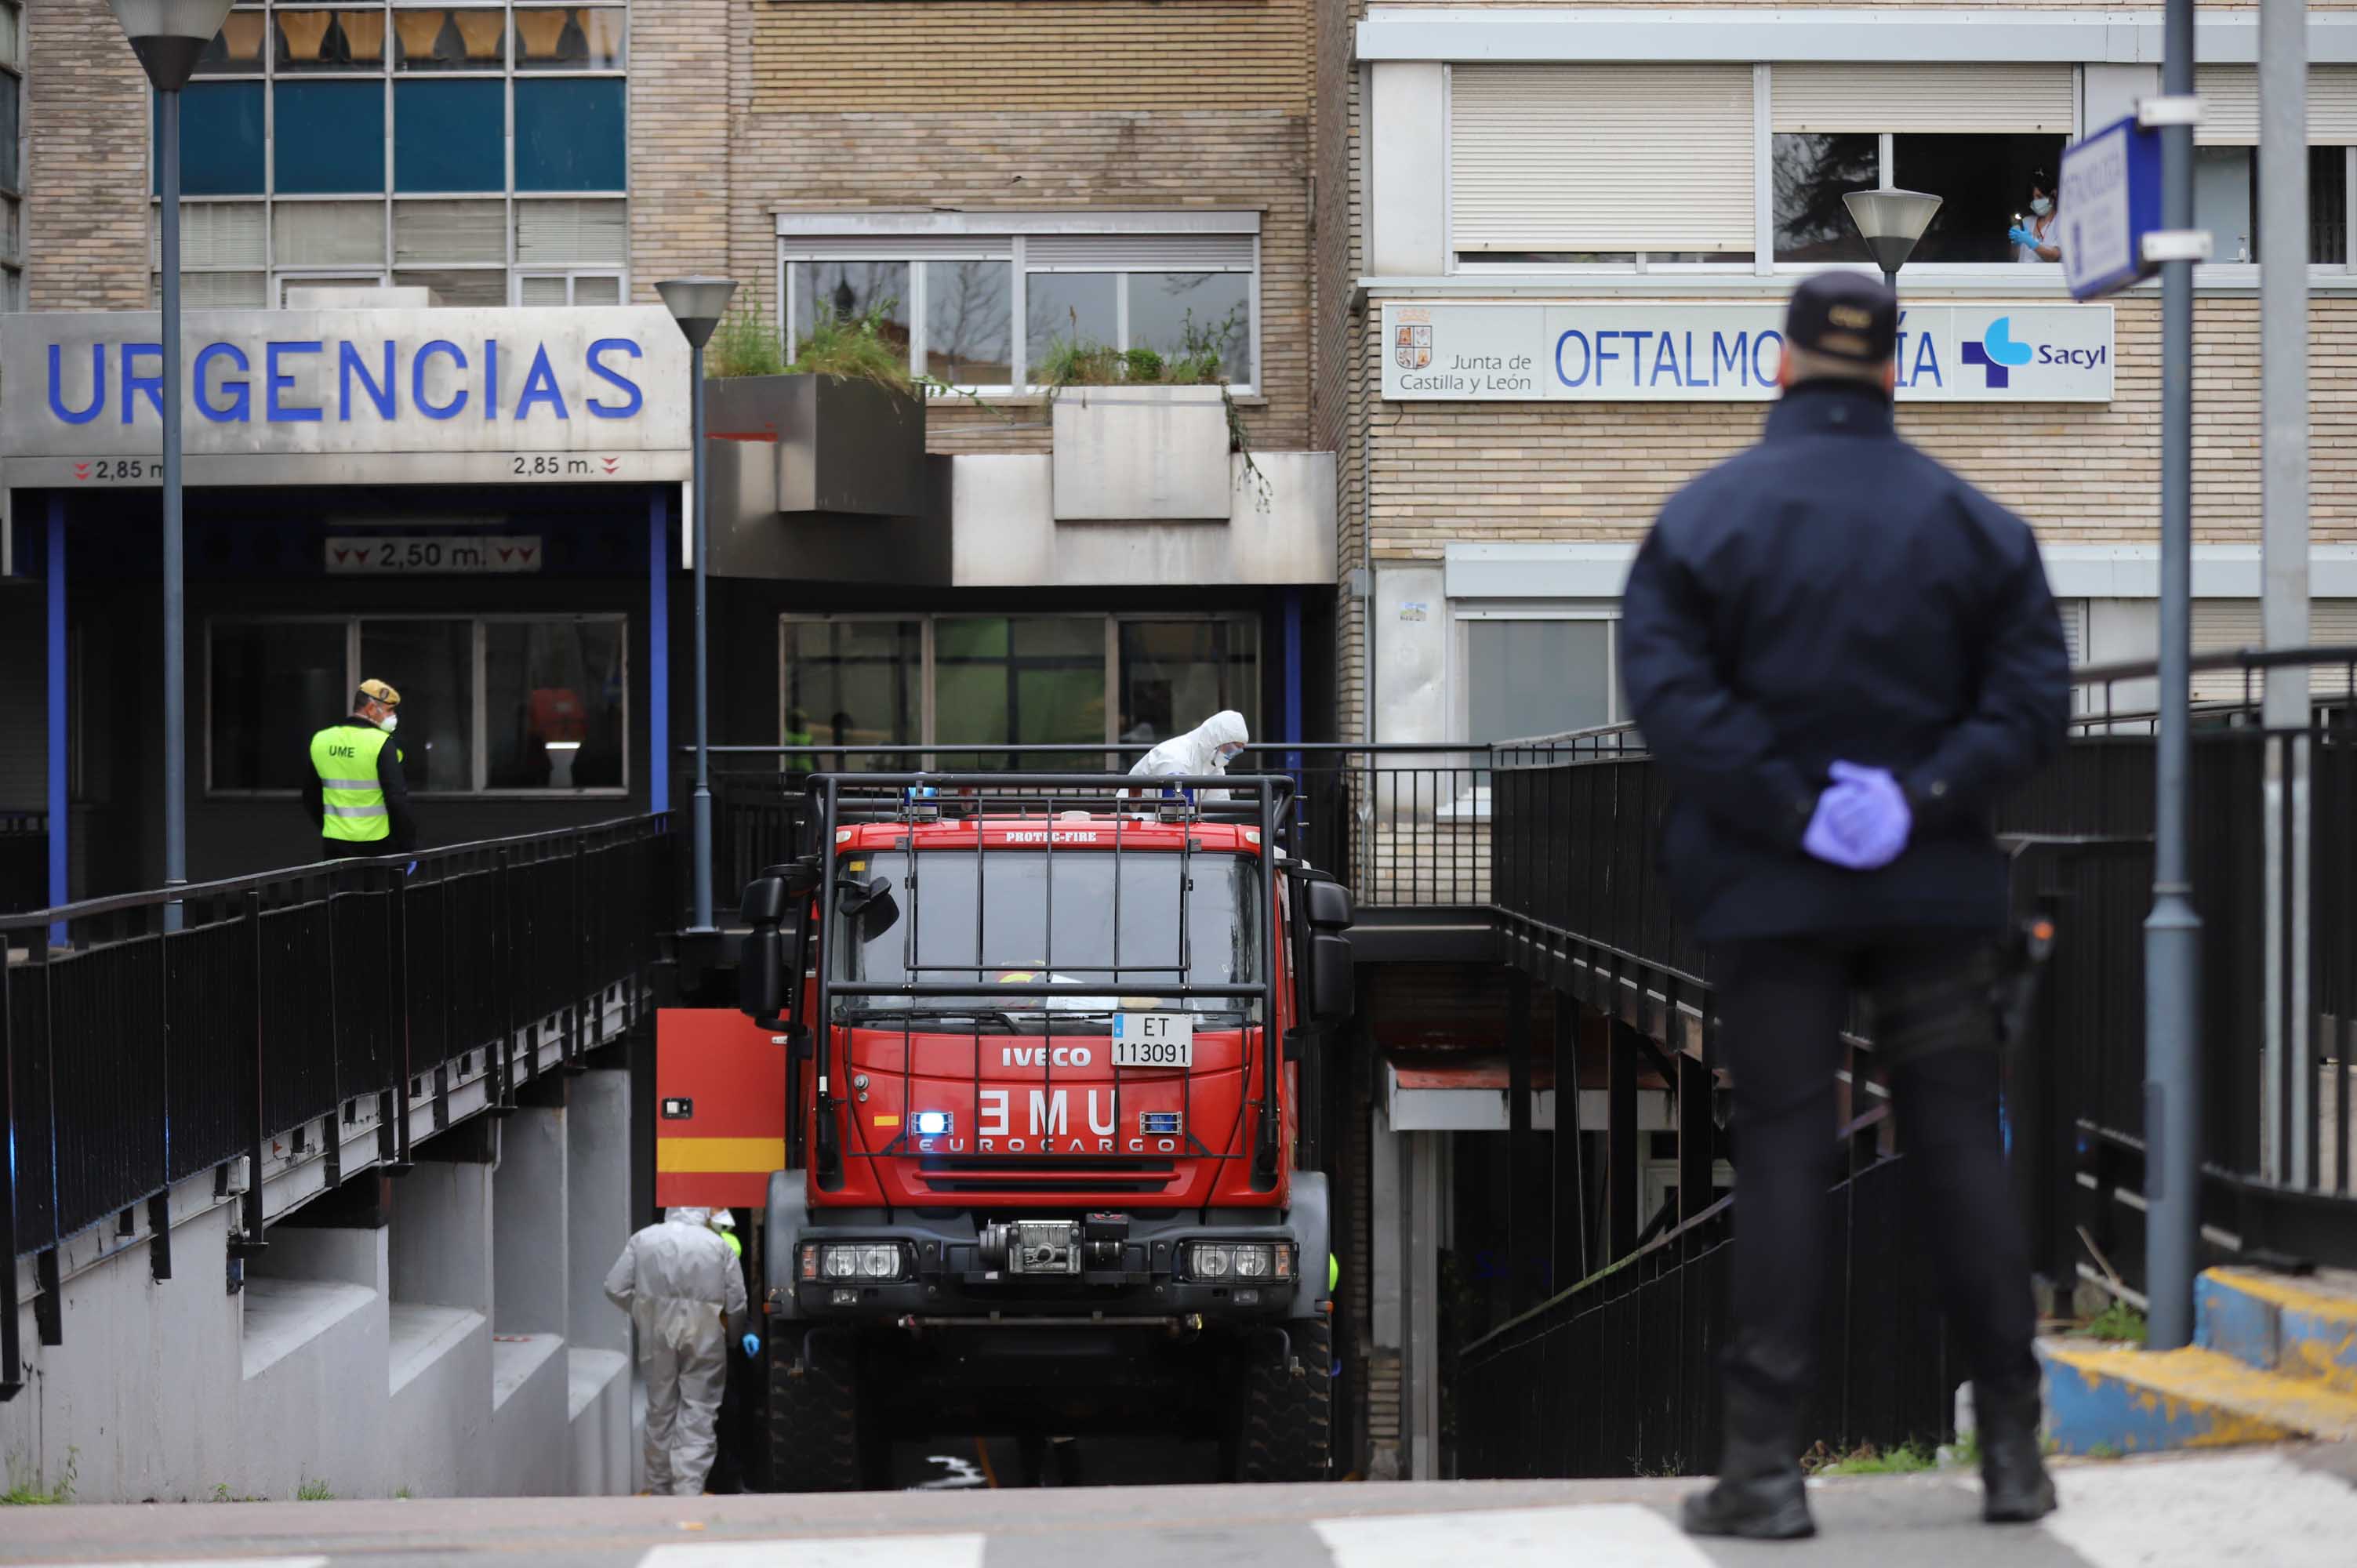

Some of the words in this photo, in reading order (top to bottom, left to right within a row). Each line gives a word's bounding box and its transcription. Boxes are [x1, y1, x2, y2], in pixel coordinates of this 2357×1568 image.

[1555, 310, 1942, 388] OFTALMOÍA
[2038, 344, 2106, 369] Sacyl
[1451, 354, 1502, 370] Junta
[1509, 354, 1531, 370] de
[48, 338, 644, 424] URGENCIAS
[1400, 374, 1464, 390] Castilla
[1469, 378, 1480, 394] y
[1487, 373, 1531, 390] León
[96, 460, 143, 481] 2,85
[514, 457, 559, 477] 2,85
[568, 460, 594, 474] m.
[380, 543, 441, 569] 2,50
[451, 549, 487, 566] m.
[329, 745, 356, 758] UME
[1005, 831, 1097, 843] PROTEC-FIRE
[1144, 1018, 1169, 1036] ET
[1002, 1047, 1091, 1067] IVECO
[1117, 1042, 1186, 1064] 113091
[919, 1138, 1175, 1152] EUROCARGO
